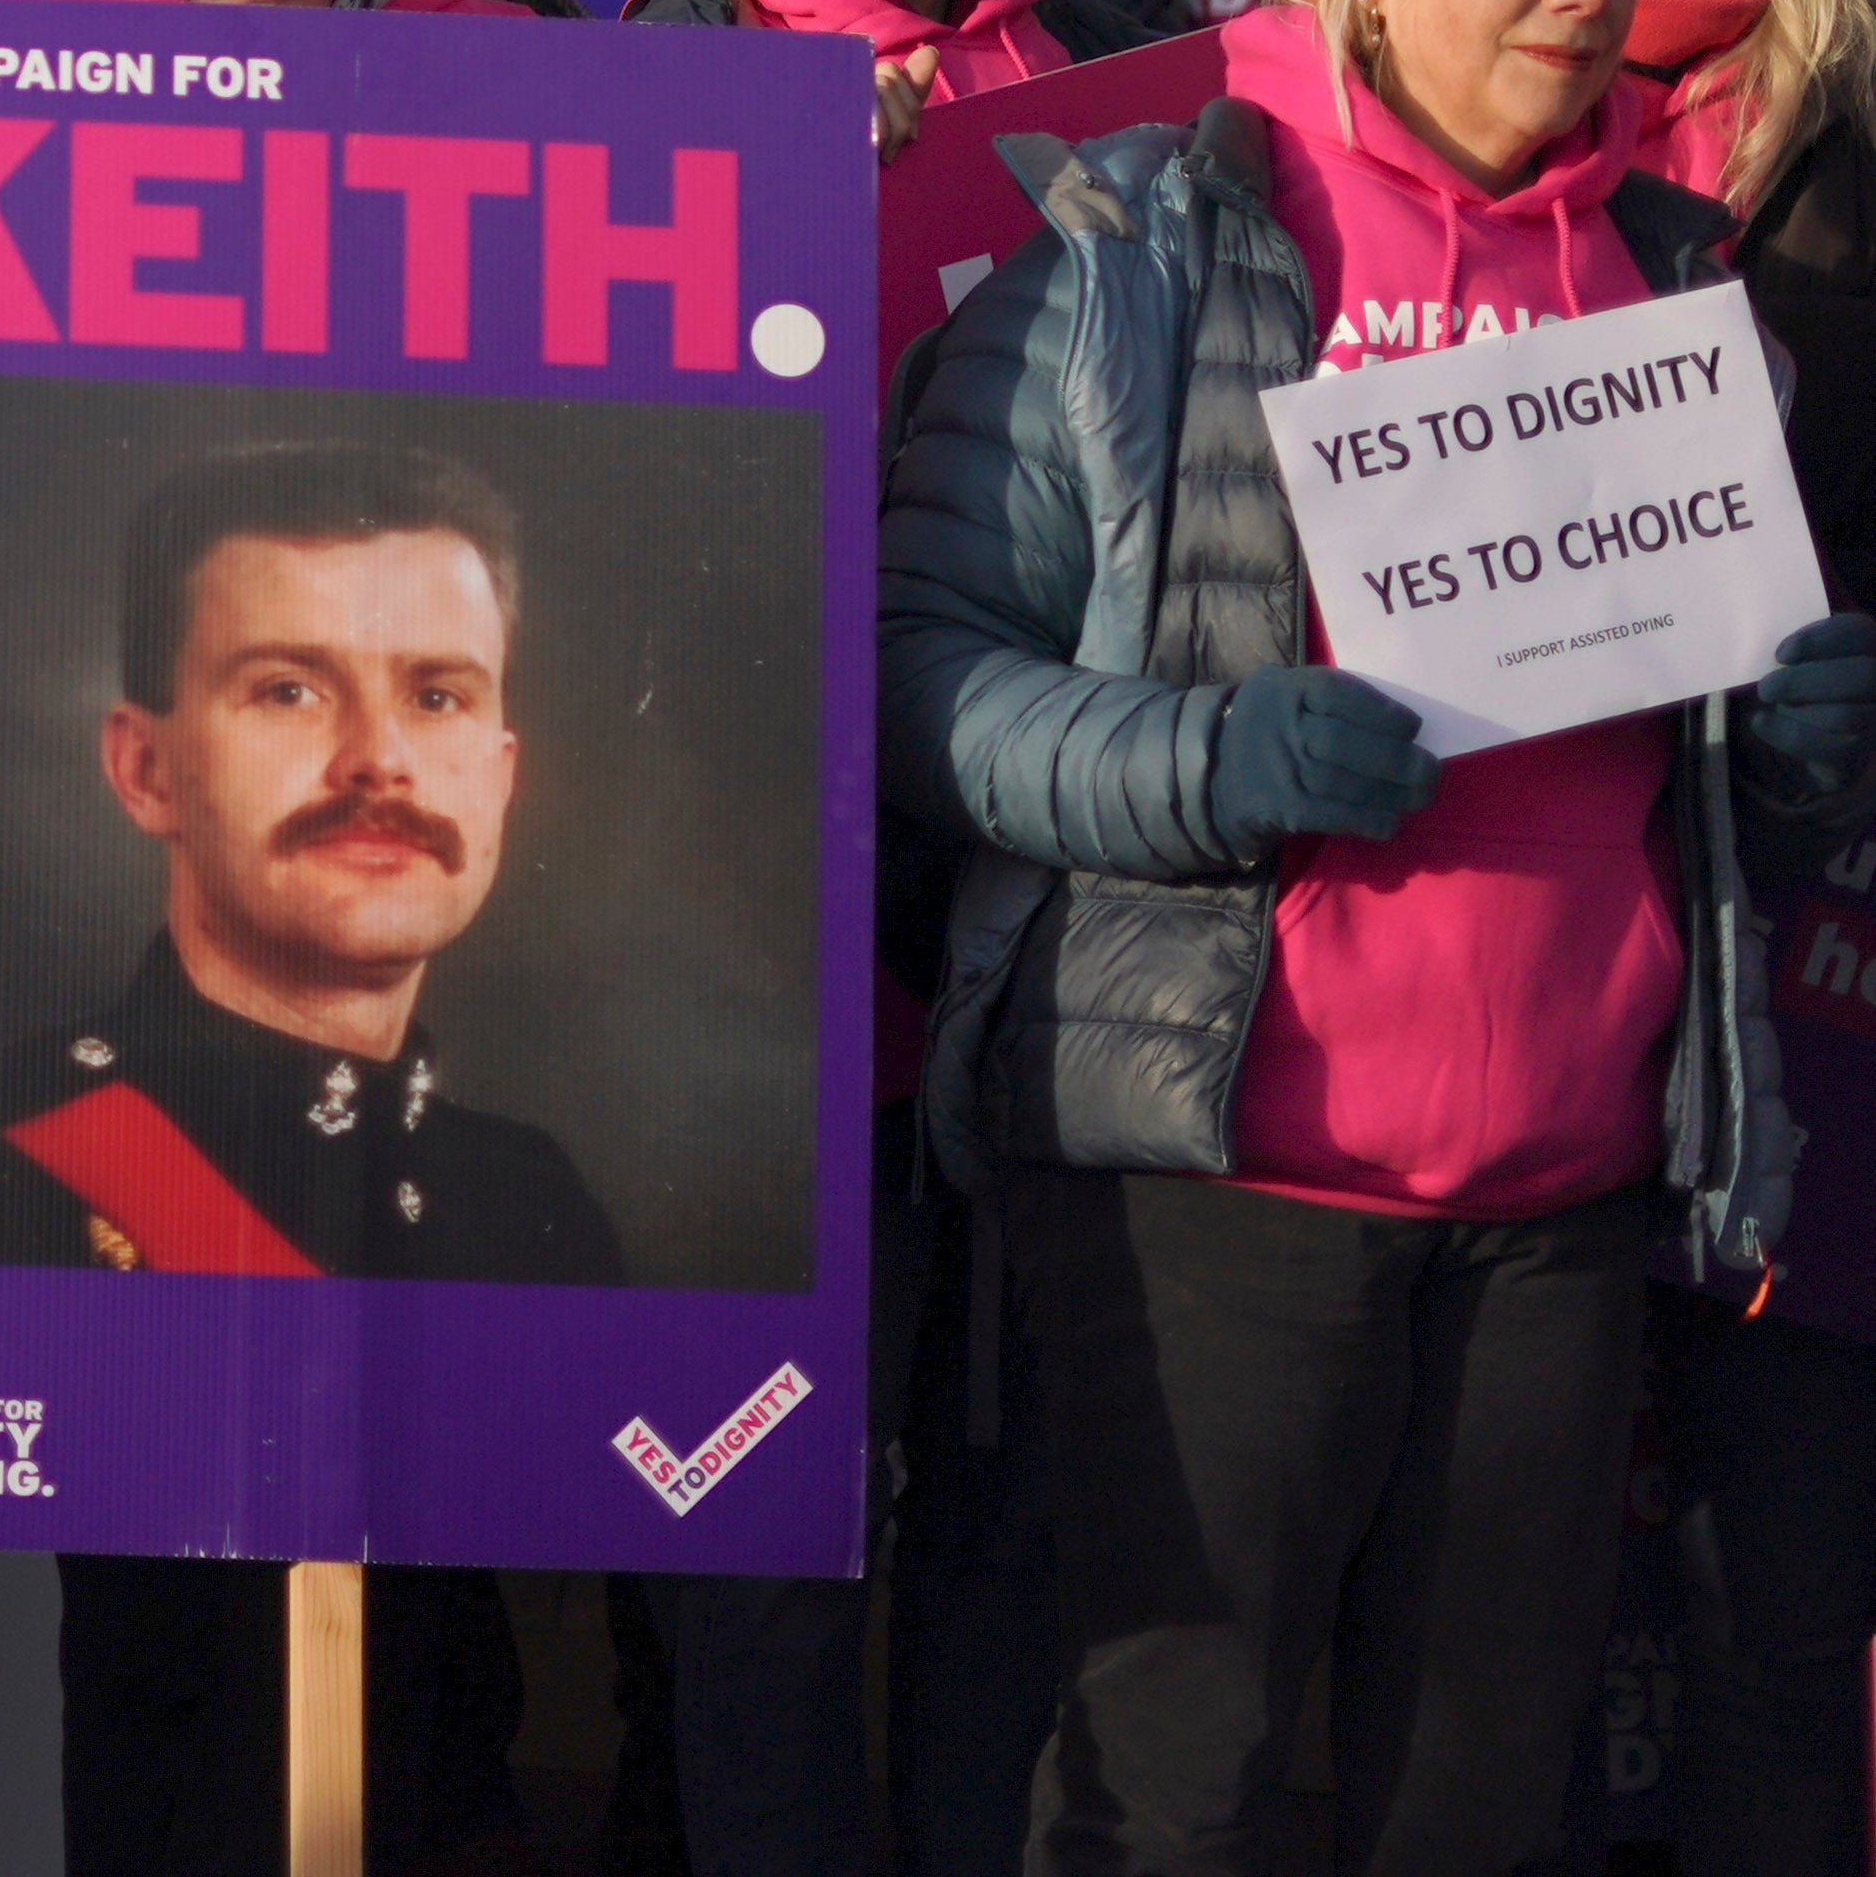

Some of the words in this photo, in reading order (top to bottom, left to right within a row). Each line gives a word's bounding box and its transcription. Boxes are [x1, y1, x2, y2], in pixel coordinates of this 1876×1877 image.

[173, 53, 283, 100] FOR
[1312, 421, 1412, 485] YES
[1418, 403, 1494, 461] TO
[1506, 347, 1723, 441] DIGNITY
[1362, 554, 1462, 615] YES
[1467, 533, 1542, 591] TO
[1557, 483, 1754, 570] CHOICE
[1496, 655, 1503, 668] I
[1504, 639, 1566, 667] SUPPORT
[1569, 624, 1630, 651] ASSISTED
[1632, 613, 1675, 636] DYING
[626, 1426, 677, 1485] YES
